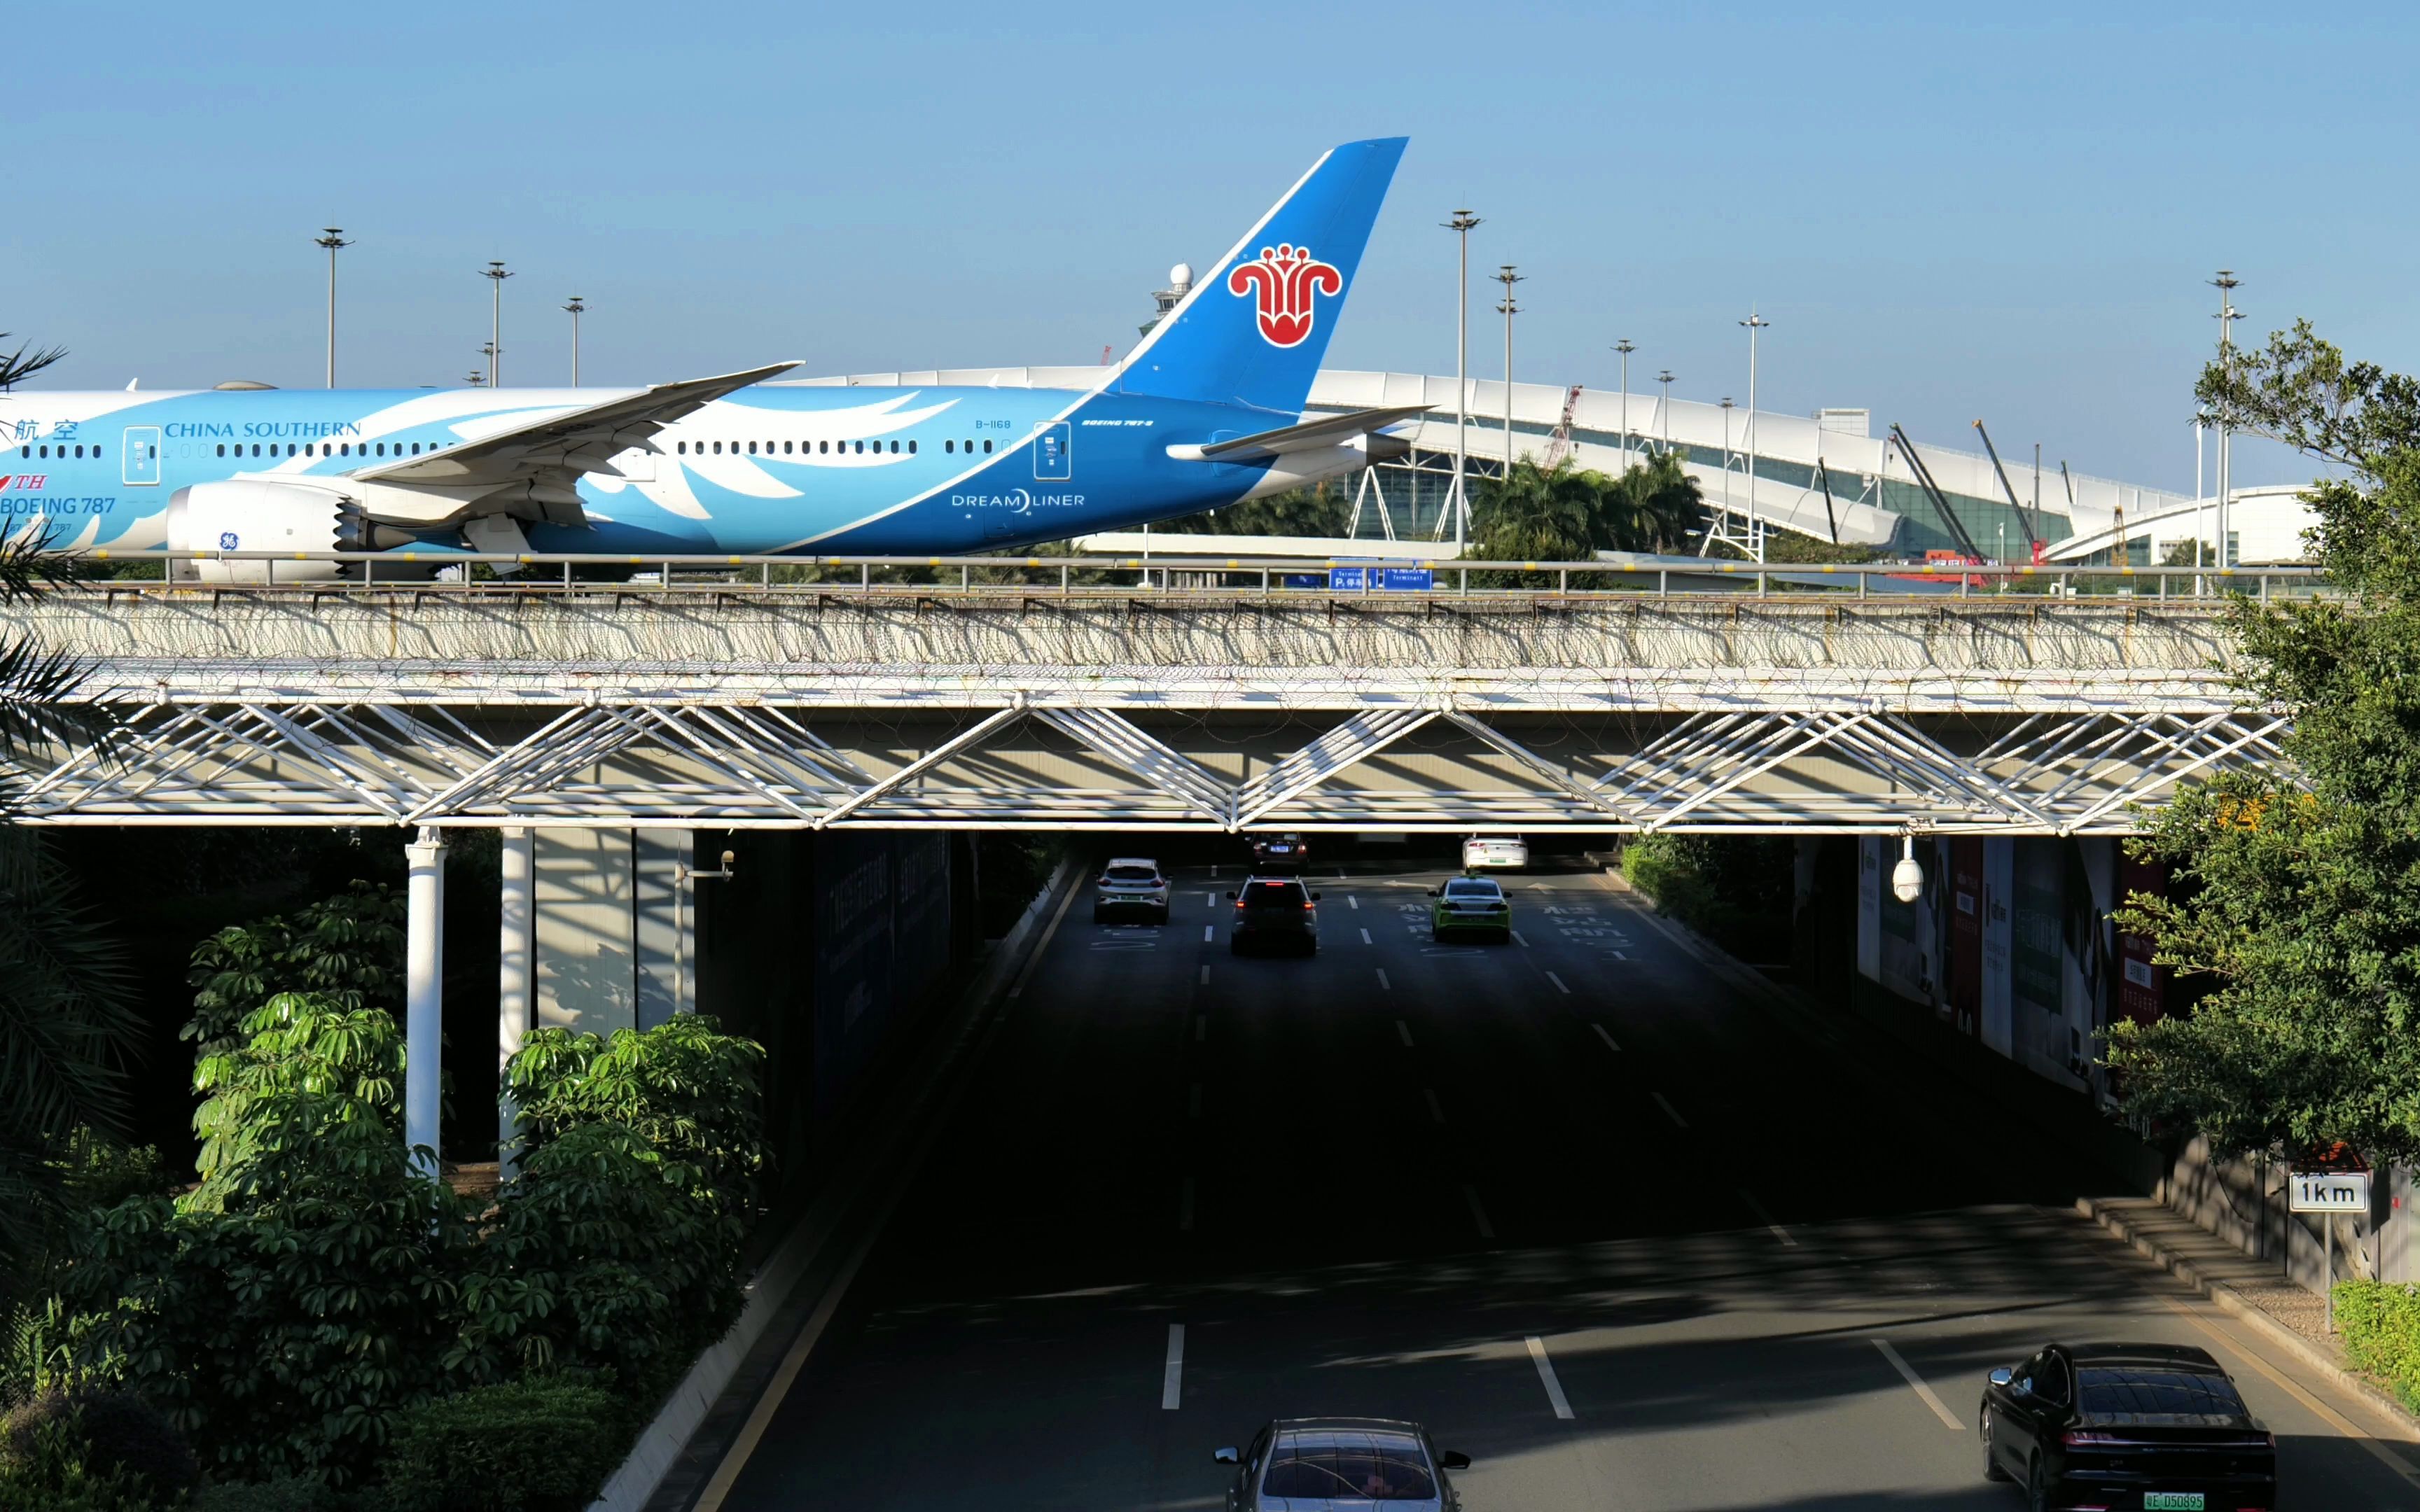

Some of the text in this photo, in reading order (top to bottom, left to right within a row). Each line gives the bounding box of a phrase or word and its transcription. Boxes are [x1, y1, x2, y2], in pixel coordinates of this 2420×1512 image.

[14, 419, 78, 440] 航空
[165, 422, 361, 438] CHINA SOUTHERN
[975, 420, 1011, 429] B-1168
[15, 475, 48, 490] TH
[1, 498, 116, 514] BOEING 787
